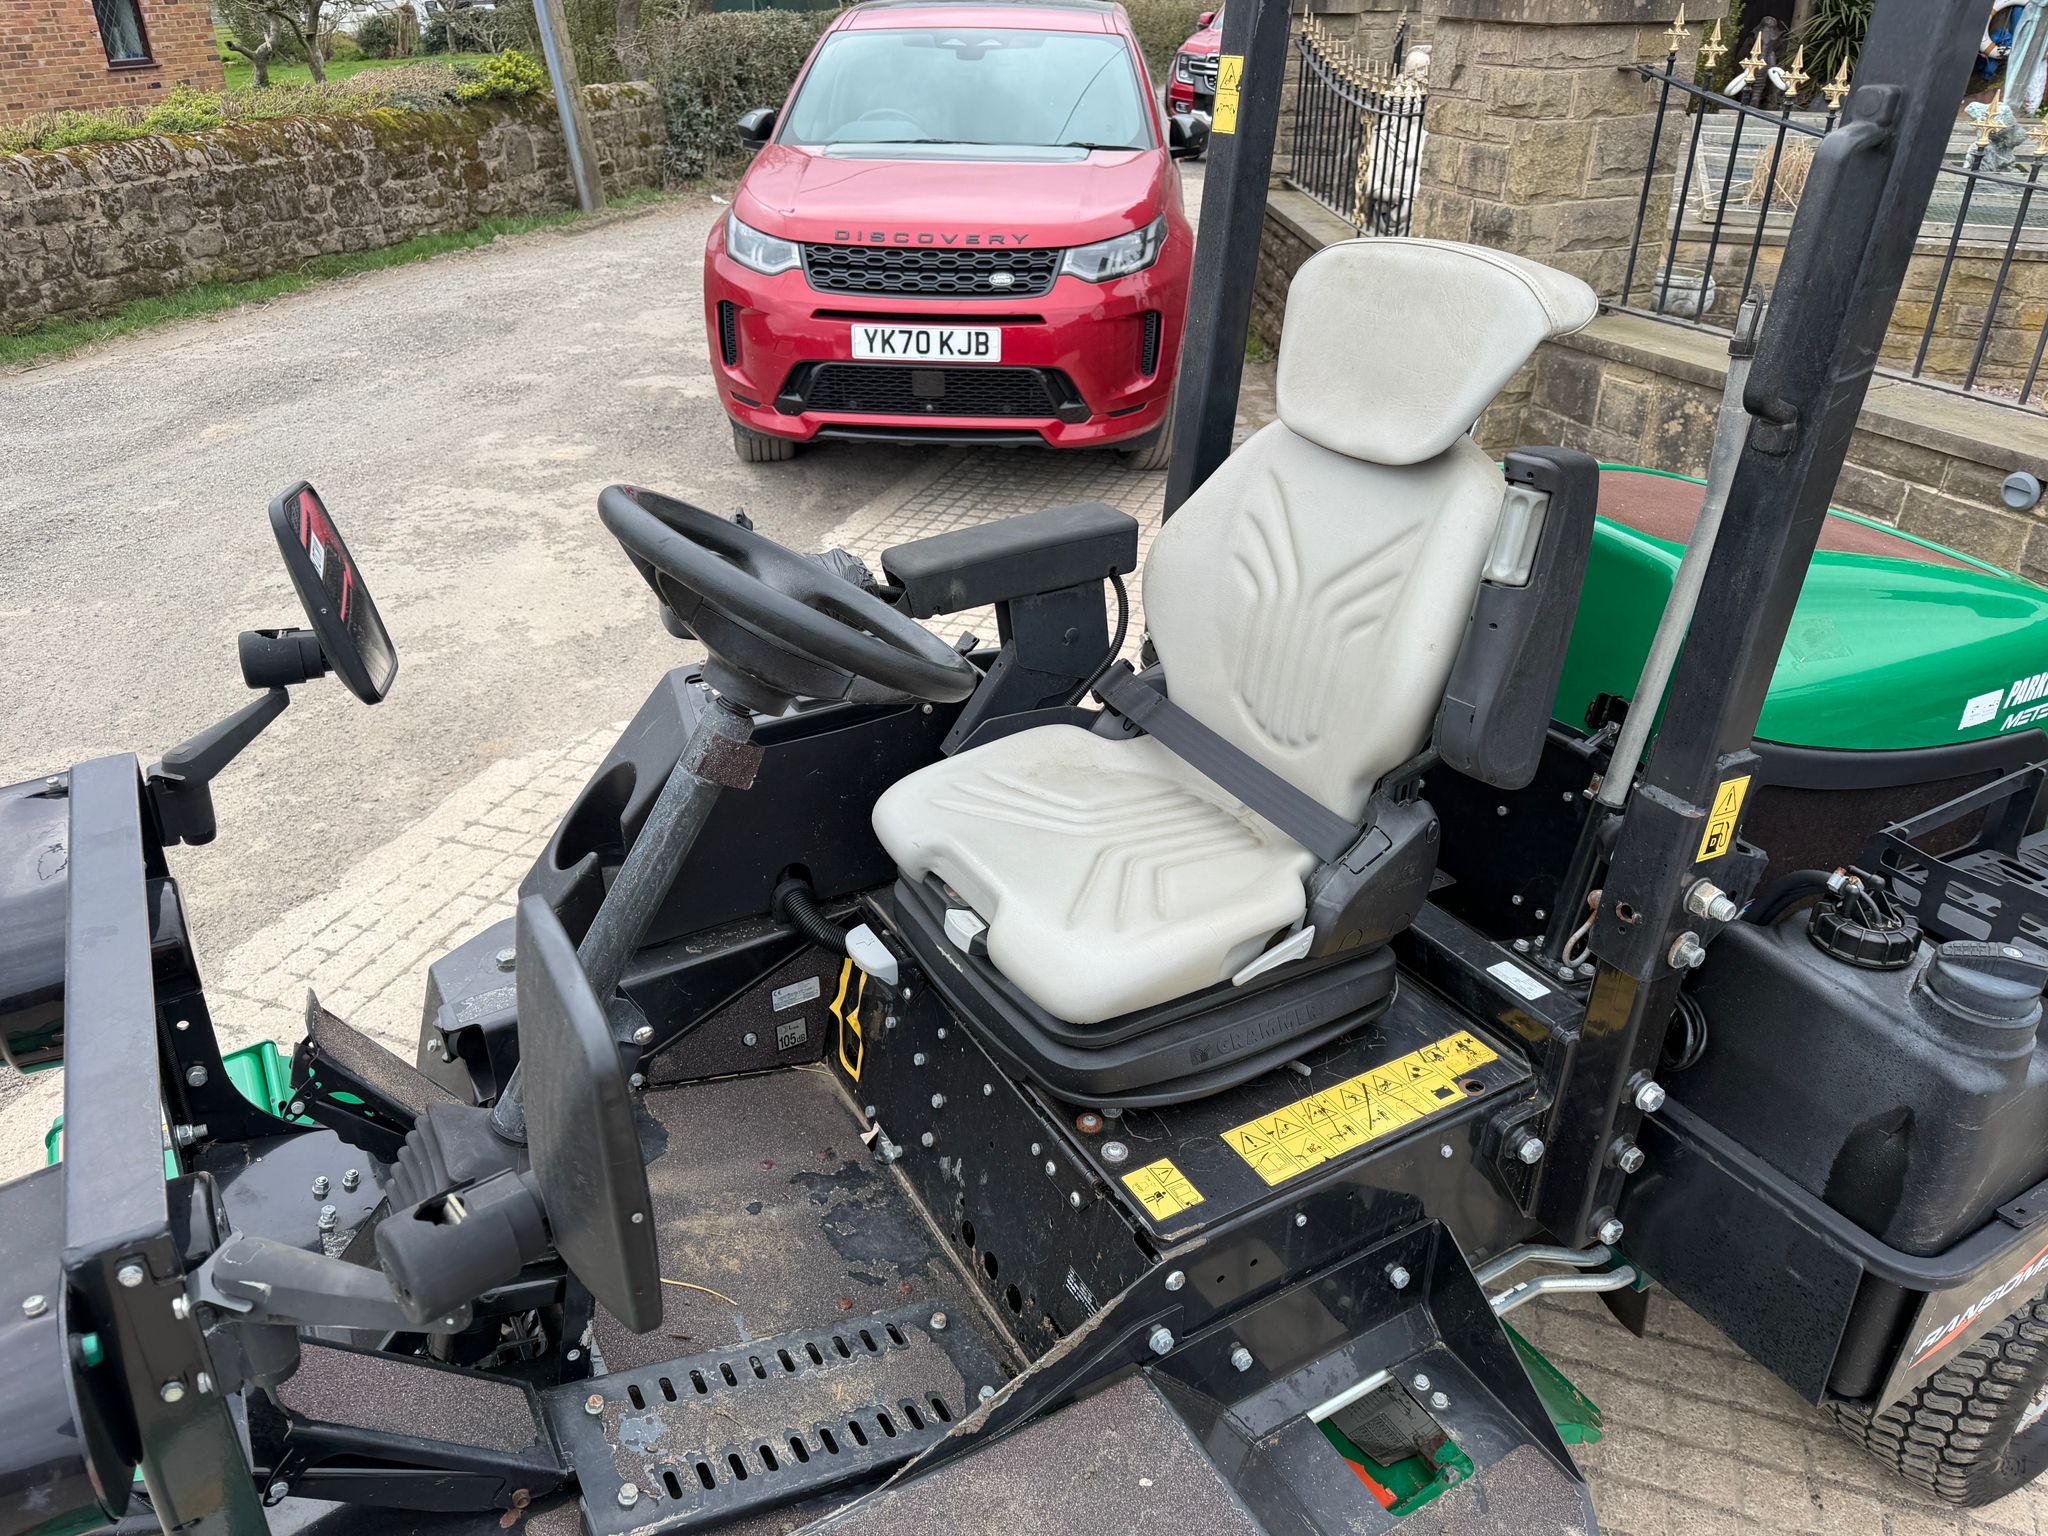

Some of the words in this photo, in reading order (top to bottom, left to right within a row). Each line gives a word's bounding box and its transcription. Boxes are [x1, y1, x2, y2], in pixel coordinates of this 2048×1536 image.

[835, 230, 1029, 245] DISCOVERY
[864, 328, 931, 355] YK70
[939, 330, 989, 356] KJB
[1709, 837, 1717, 847] D
[1216, 1003, 1322, 1055] GRAMMER
[779, 1032, 796, 1049] 105
[797, 1033, 806, 1043] dB
